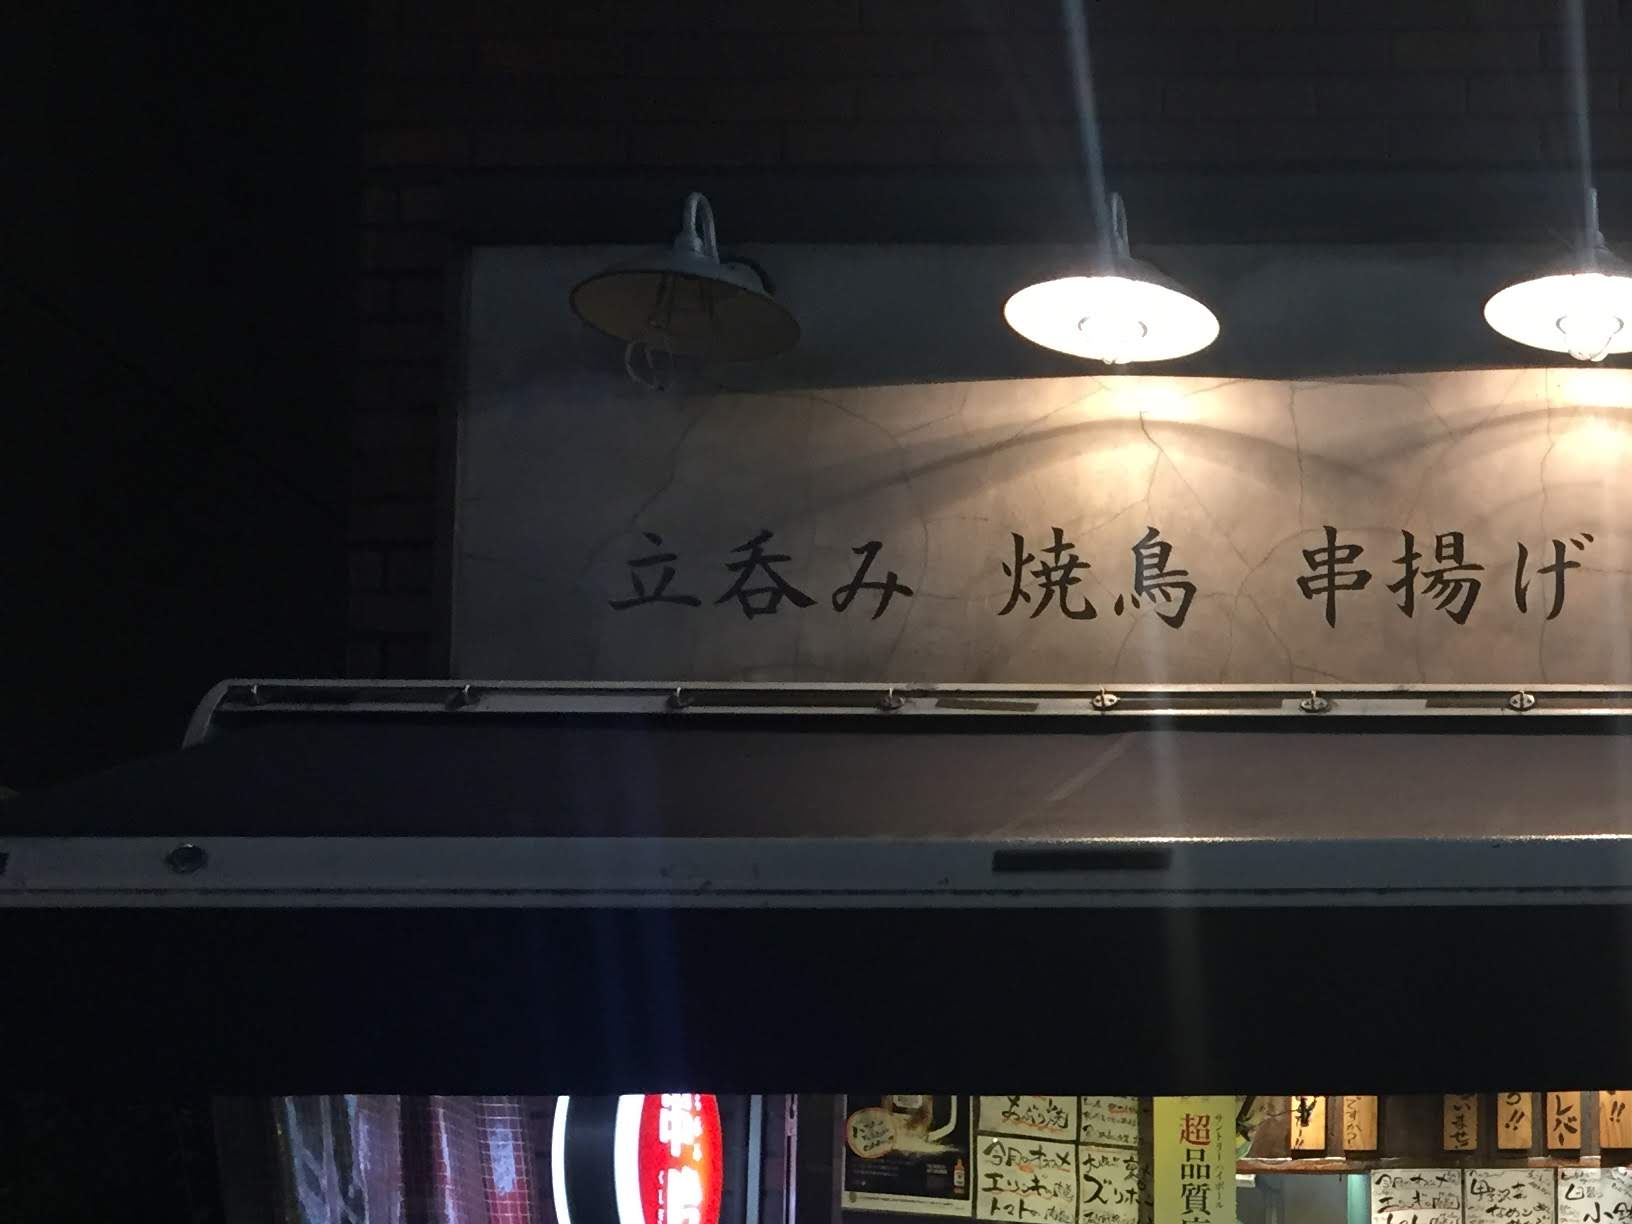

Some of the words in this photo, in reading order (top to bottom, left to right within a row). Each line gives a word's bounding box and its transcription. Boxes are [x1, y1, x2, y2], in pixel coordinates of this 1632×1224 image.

[607, 530, 915, 620] 立呑み
[999, 524, 1196, 627] 焼鳥
[1294, 524, 1596, 630] 串揚げ
[1552, 1094, 1578, 1147] レバー
